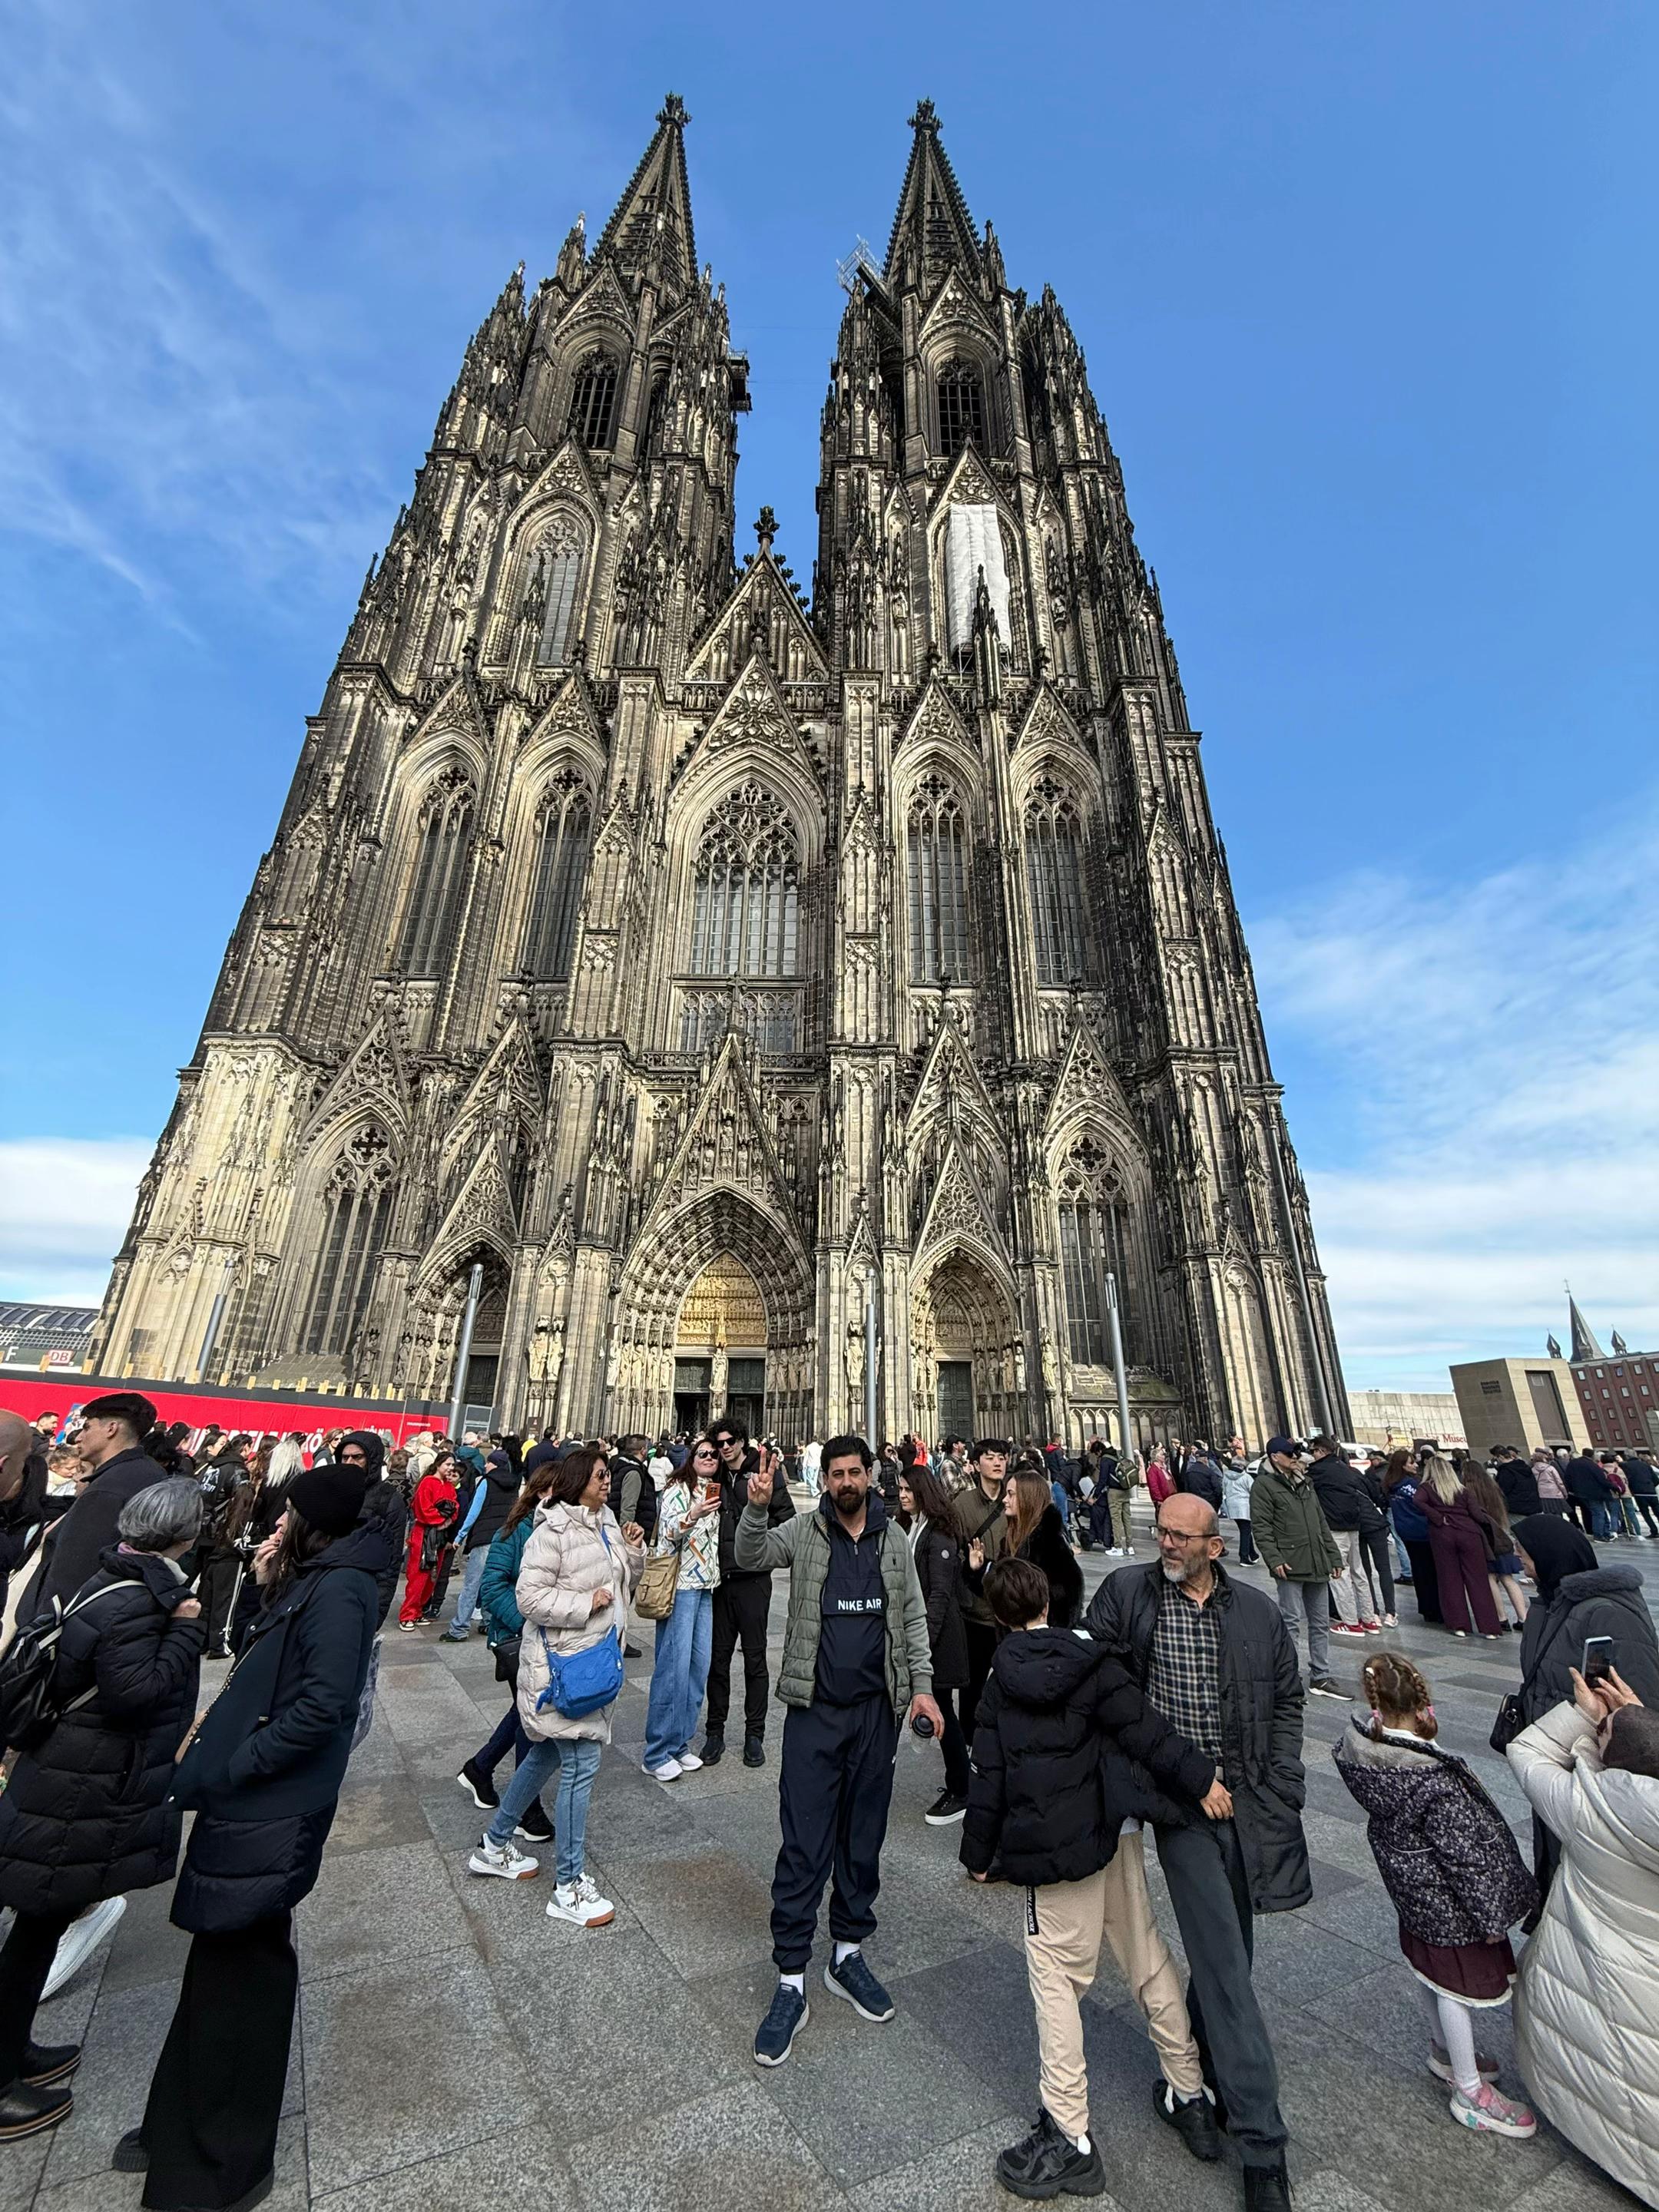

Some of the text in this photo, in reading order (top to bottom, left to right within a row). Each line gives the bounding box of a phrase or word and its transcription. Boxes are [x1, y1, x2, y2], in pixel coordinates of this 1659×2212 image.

[50, 1351, 69, 1362] DB
[837, 1598, 882, 1611] NIKE AIR
